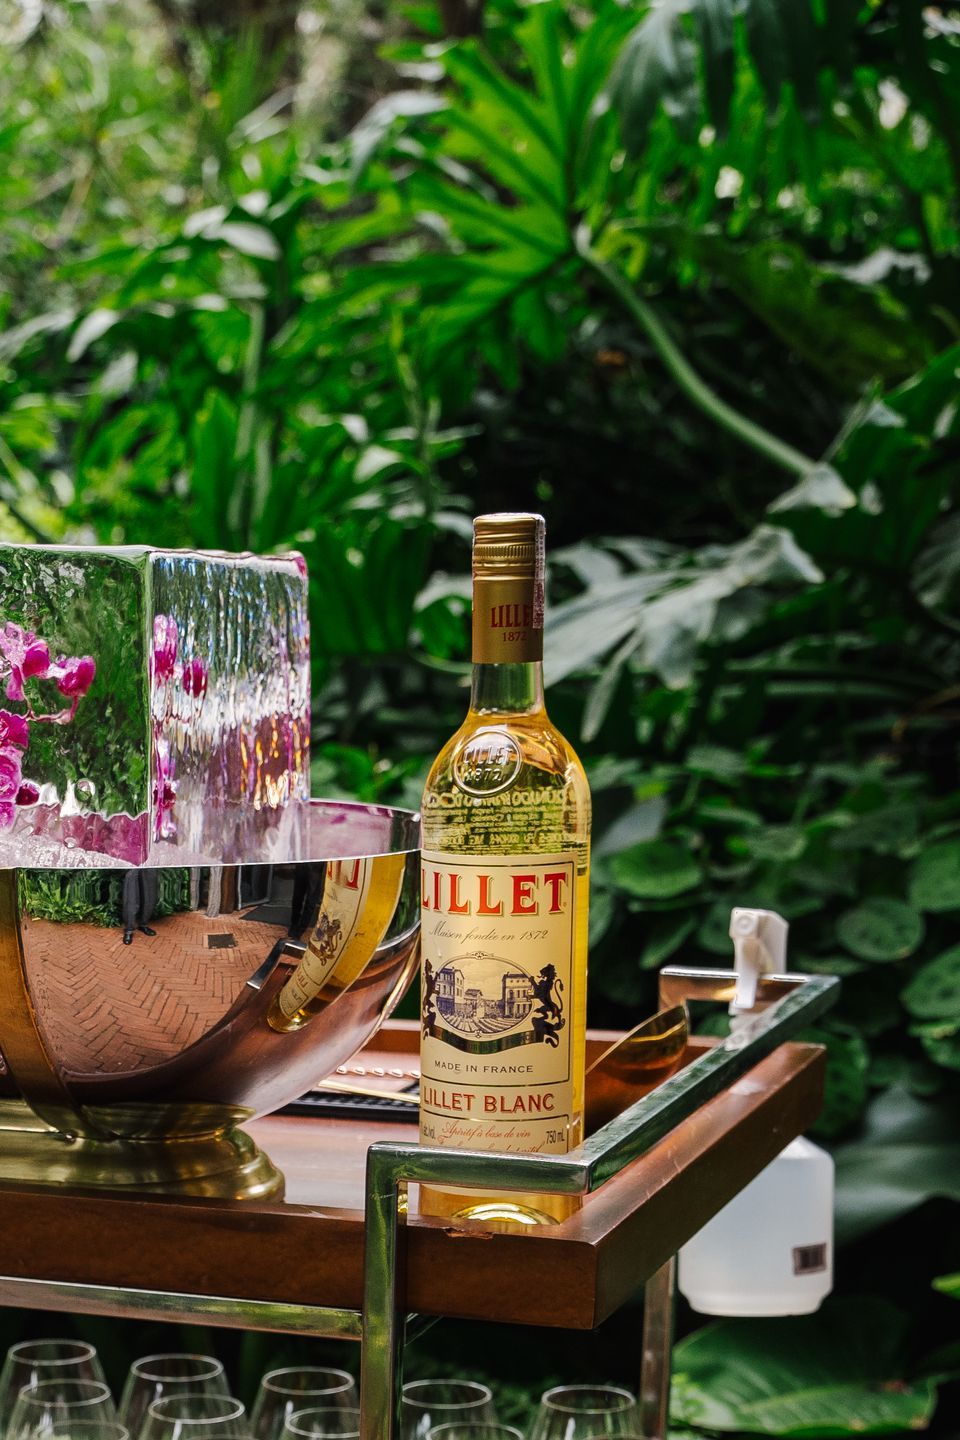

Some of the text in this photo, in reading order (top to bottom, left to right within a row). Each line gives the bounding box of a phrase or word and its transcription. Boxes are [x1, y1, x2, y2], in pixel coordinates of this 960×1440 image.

[491, 604, 533, 628] LILLE
[502, 631, 528, 642] 1872
[463, 744, 513, 765] LILLET
[465, 767, 503, 782] 1872
[422, 868, 568, 917] LILLET
[428, 920, 463, 940] Maison
[519, 929, 549, 942] 1872
[434, 1060, 534, 1074] MADE IN FRANCE
[423, 1085, 555, 1114] LILLET BLANC
[504, 1125, 515, 1138] de
[516, 1130, 531, 1138] vin
[546, 1130, 556, 1144] 750
